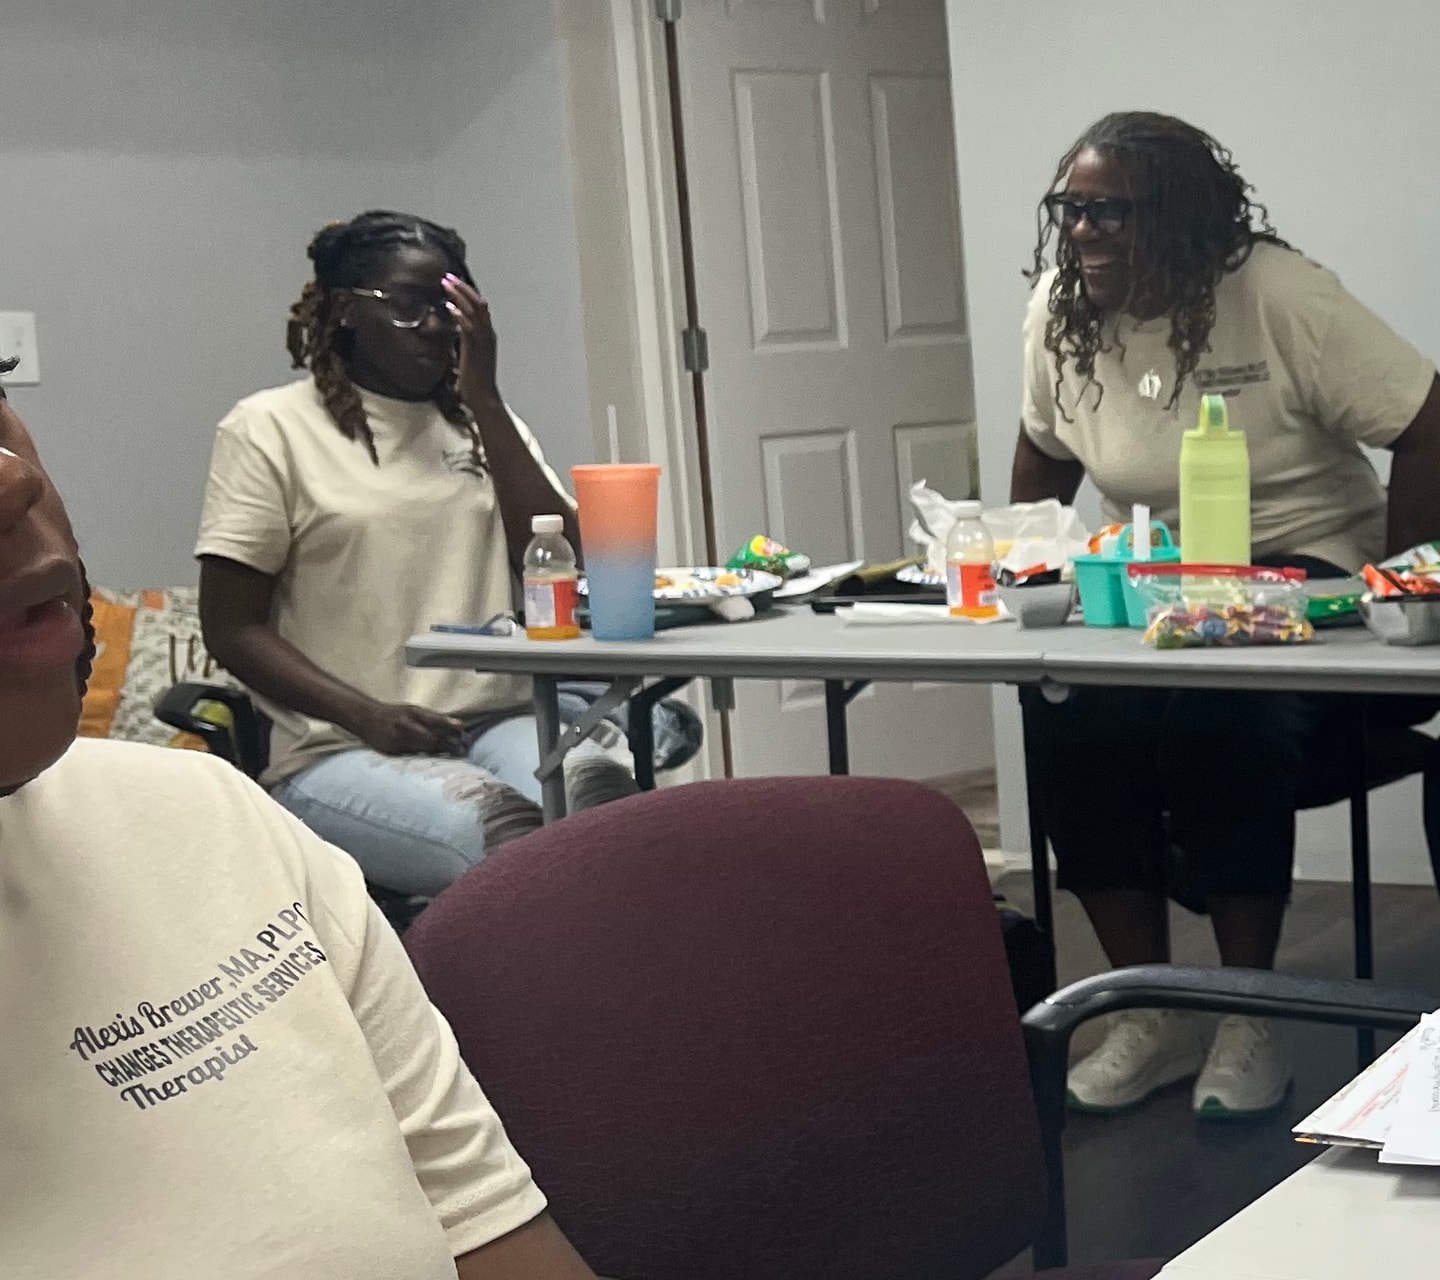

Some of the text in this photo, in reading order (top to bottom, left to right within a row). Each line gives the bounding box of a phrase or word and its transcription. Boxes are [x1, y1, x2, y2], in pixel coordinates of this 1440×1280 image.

[70, 1013, 144, 1060] Alexis
[138, 977, 223, 1029] Brewer
[94, 940, 327, 1088] CHANGES THERAPEUTIC SERVICES
[120, 1033, 258, 1110] Therapist
